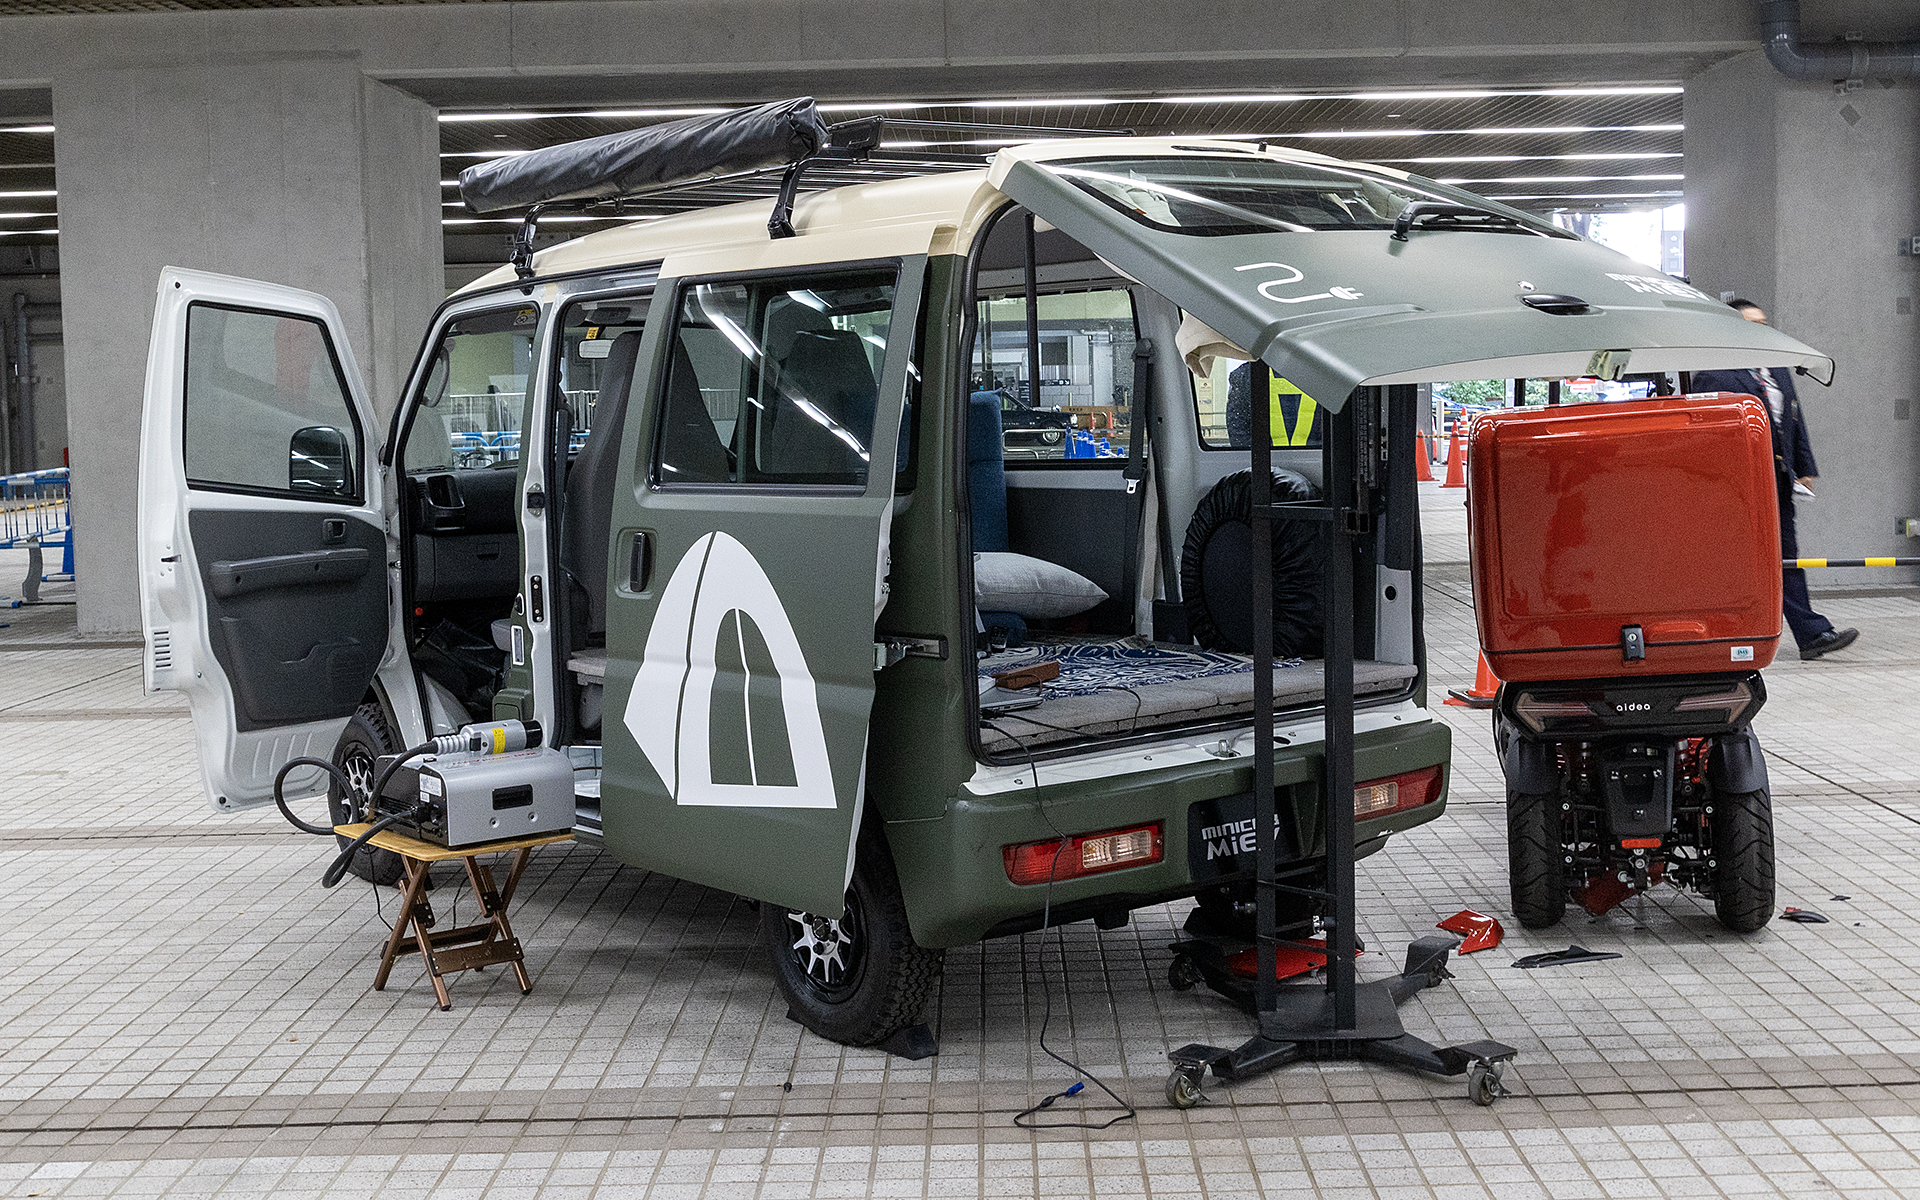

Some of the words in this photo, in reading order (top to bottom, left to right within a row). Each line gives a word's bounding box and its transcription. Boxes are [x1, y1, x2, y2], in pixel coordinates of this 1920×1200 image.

[1616, 702, 1650, 711] aidea
[1201, 813, 1280, 840] MINIC
[1206, 826, 1280, 860] MiE
